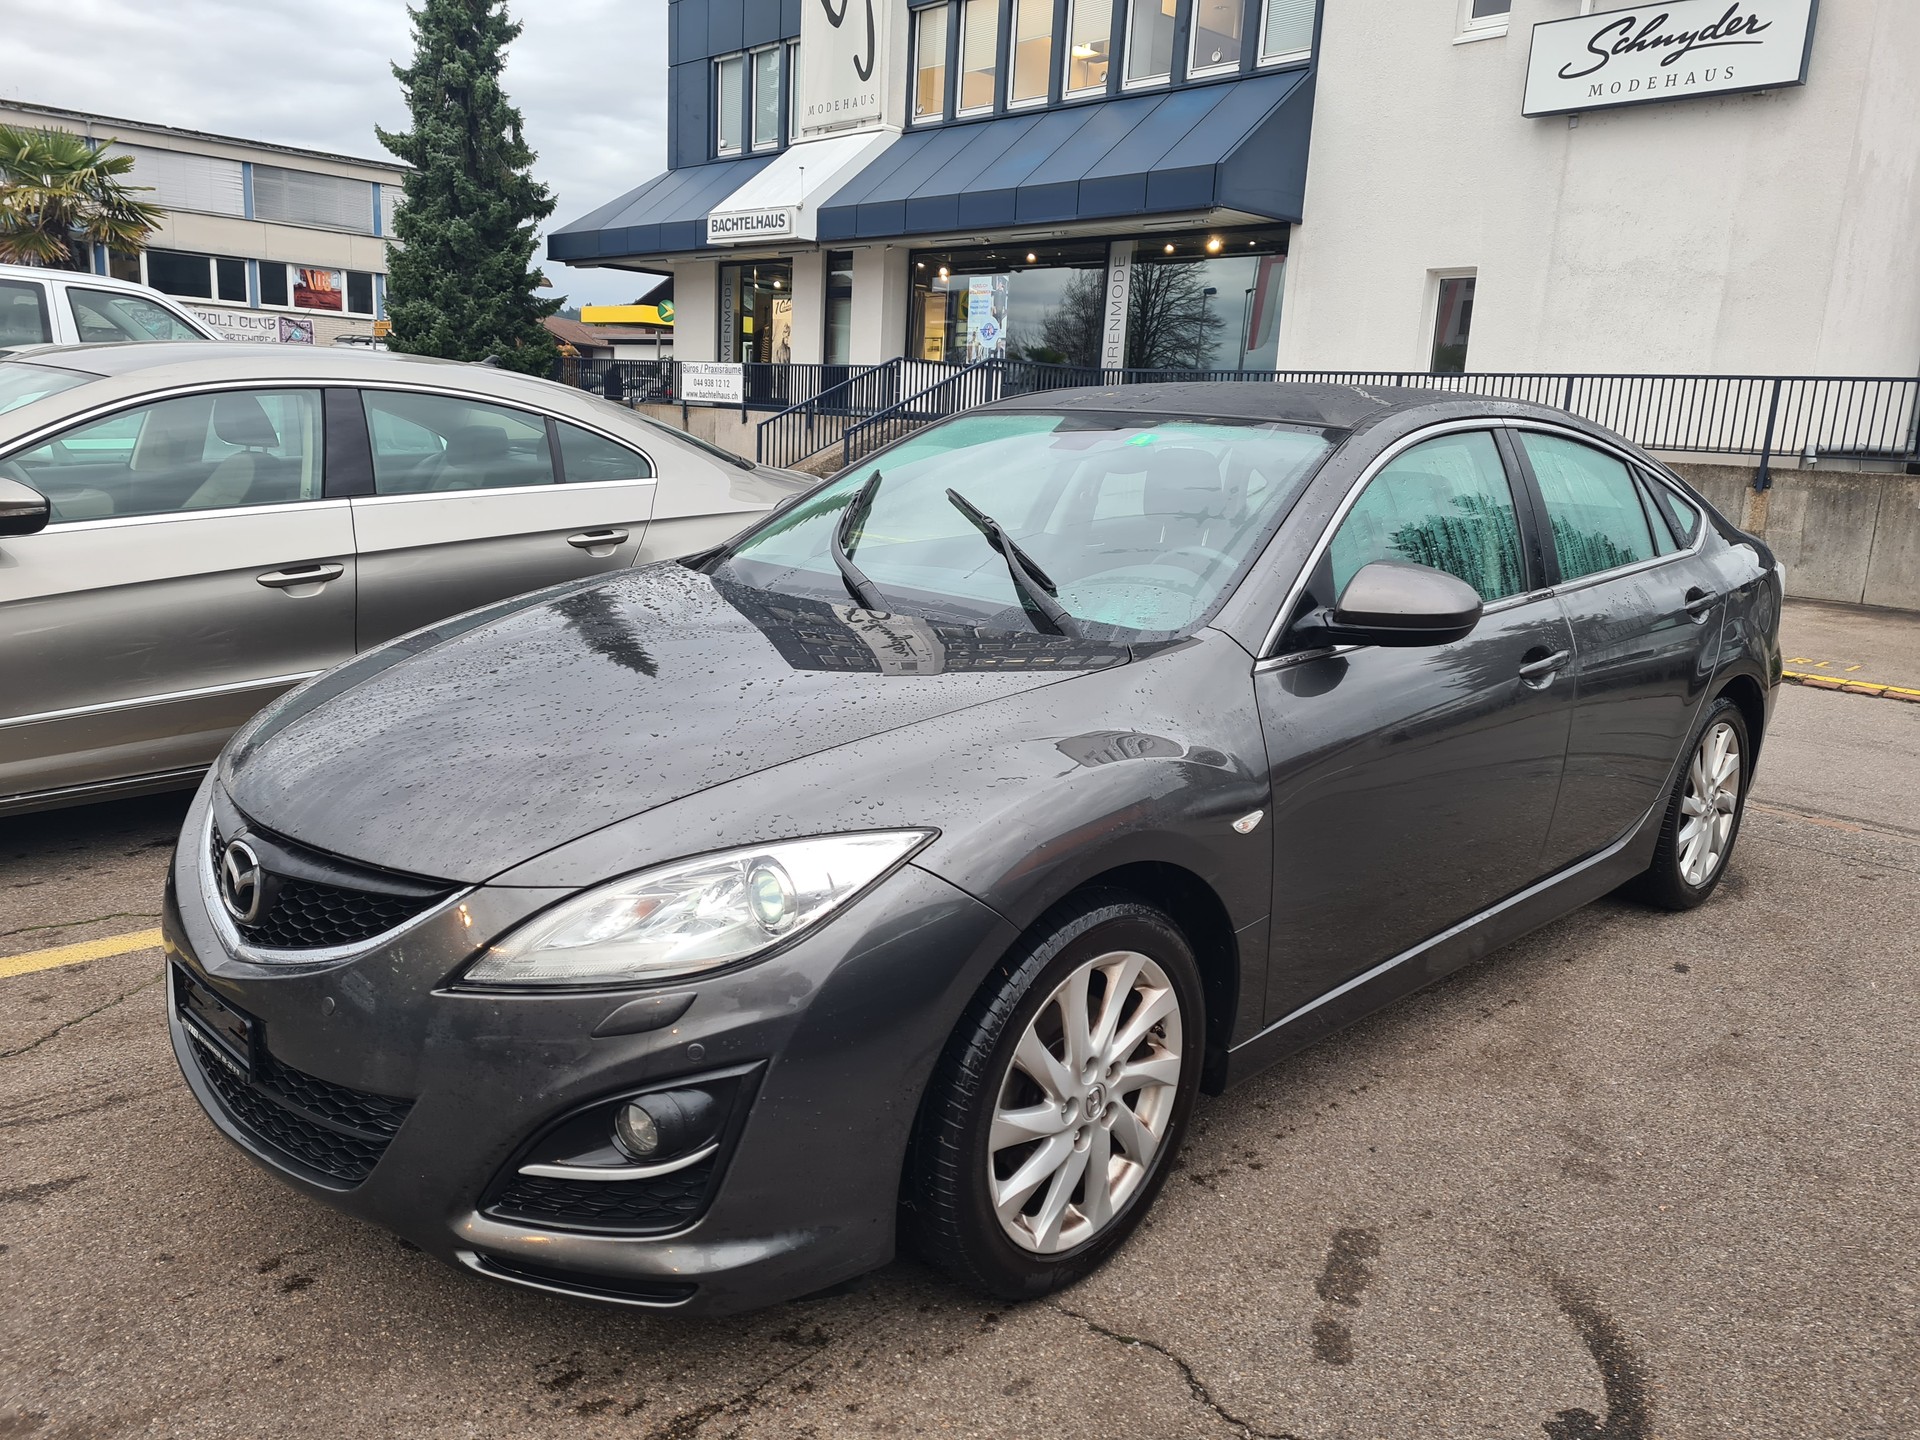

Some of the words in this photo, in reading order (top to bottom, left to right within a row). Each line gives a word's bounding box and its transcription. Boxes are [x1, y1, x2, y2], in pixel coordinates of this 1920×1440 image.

[1558, 2, 1773, 79] Schnyder
[1587, 66, 1735, 98] MODEHAUS
[807, 93, 876, 116] MODEHAUS
[711, 213, 786, 233] BACHTELHAUS
[194, 312, 233, 327] POLI
[683, 363, 699, 373] Büros
[704, 363, 742, 374] Praxisräume
[693, 378, 703, 387] 044
[704, 379, 714, 388] 938
[715, 379, 722, 388] 12
[723, 379, 730, 388] 12
[686, 389, 739, 400] www.bachtelhaus.ch
